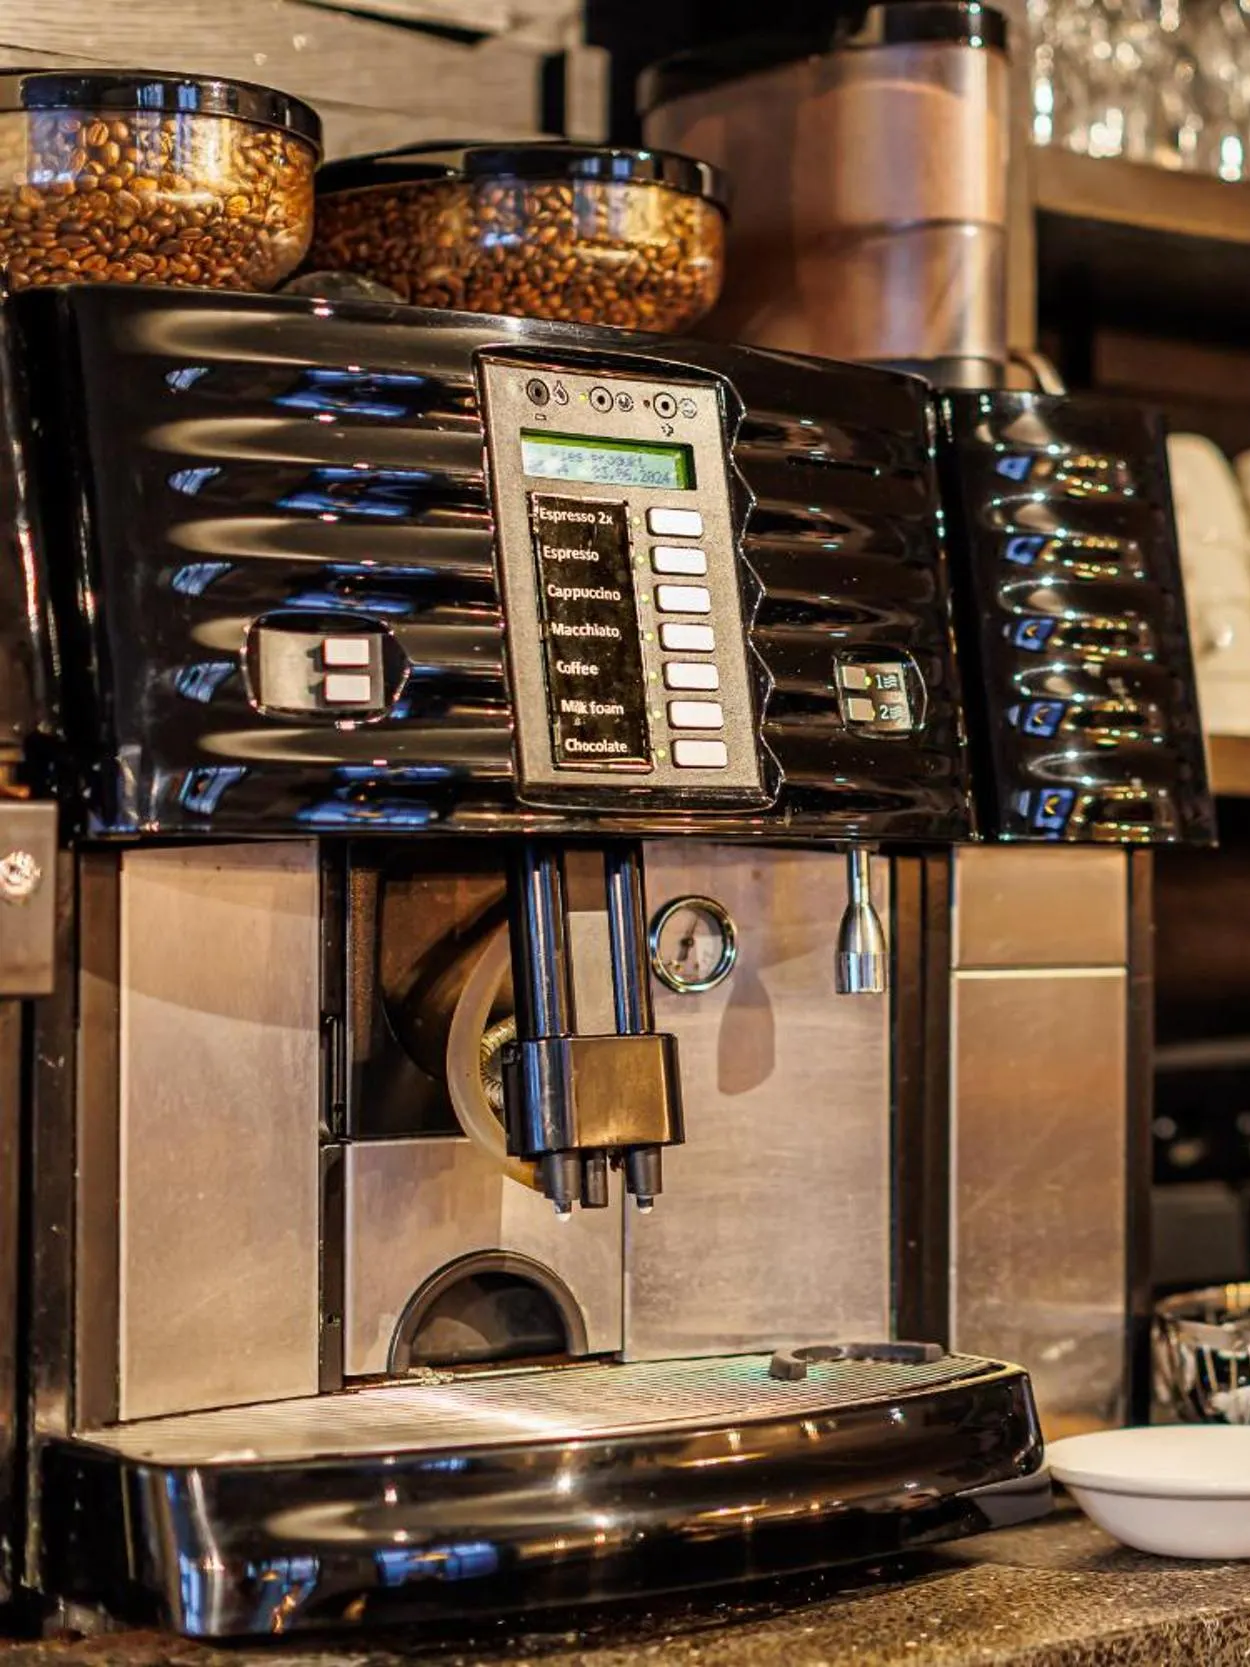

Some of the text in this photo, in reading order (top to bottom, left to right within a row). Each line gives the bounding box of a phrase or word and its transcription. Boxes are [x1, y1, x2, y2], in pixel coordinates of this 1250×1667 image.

[540, 507, 614, 525] Espresso 2x
[543, 545, 600, 562] Espresso
[547, 584, 622, 601] Cappuccino
[551, 622, 620, 638] Macchiato
[556, 660, 600, 676] Coffee
[561, 699, 625, 715] Milk foam
[564, 738, 628, 753] Chocolate
